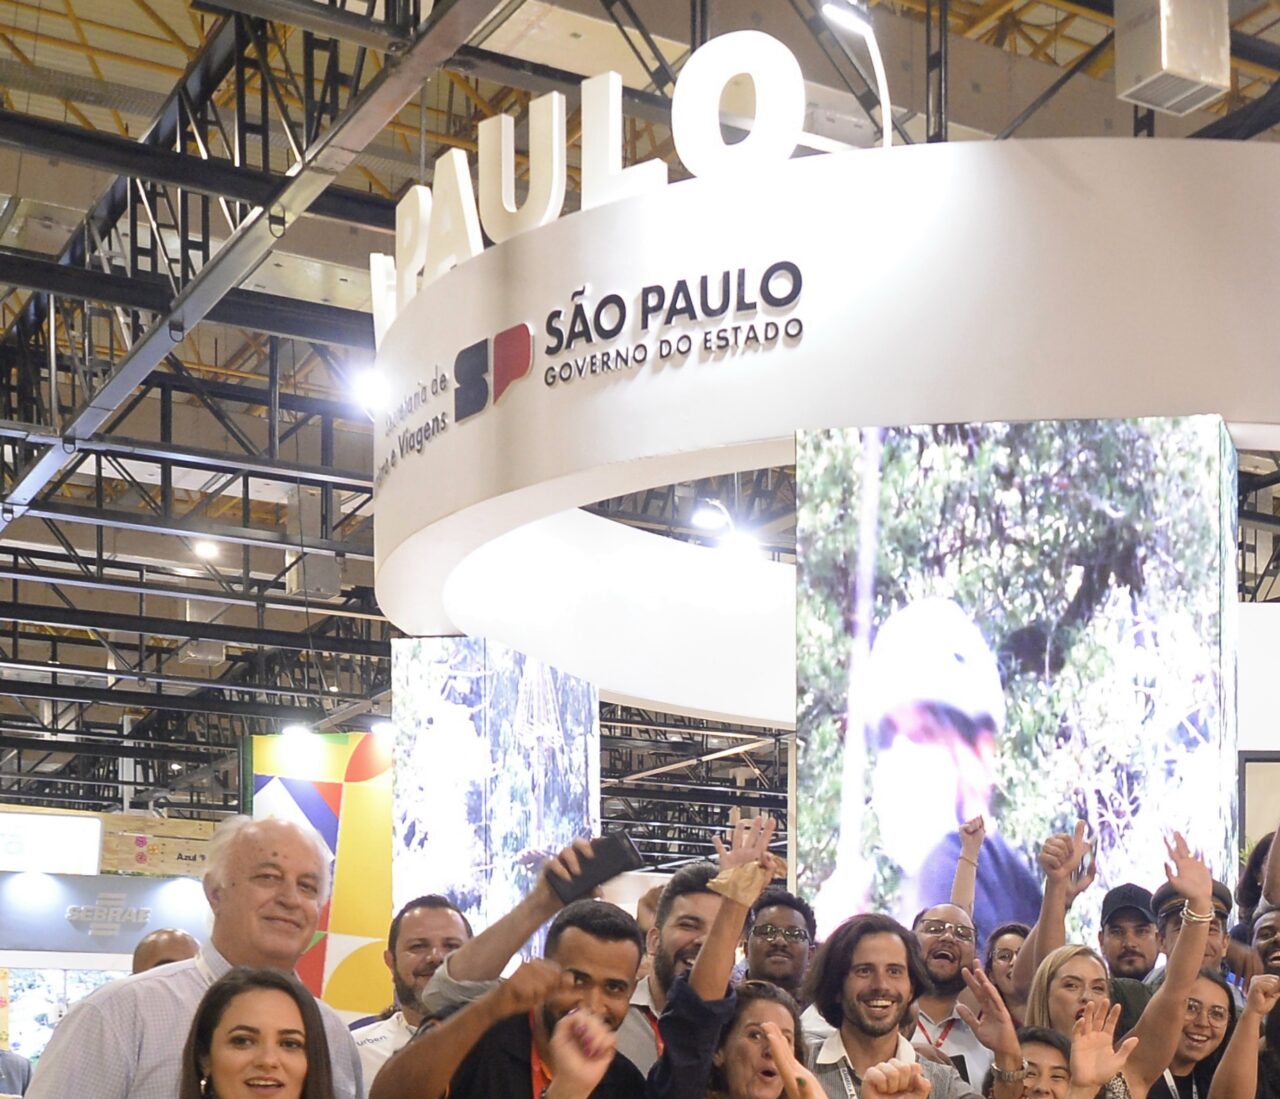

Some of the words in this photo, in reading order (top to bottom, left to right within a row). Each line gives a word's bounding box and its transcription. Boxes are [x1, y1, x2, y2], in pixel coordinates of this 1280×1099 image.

[395, 29, 806, 297] PAULO
[544, 285, 626, 356] SÃO
[641, 261, 802, 330] PAULO
[431, 364, 447, 395] de
[544, 343, 648, 386] GOVERNO
[659, 334, 692, 359] DO
[704, 317, 803, 351] ESTADO
[398, 412, 447, 459] Viagens
[66, 905, 151, 922] SEBRAE
